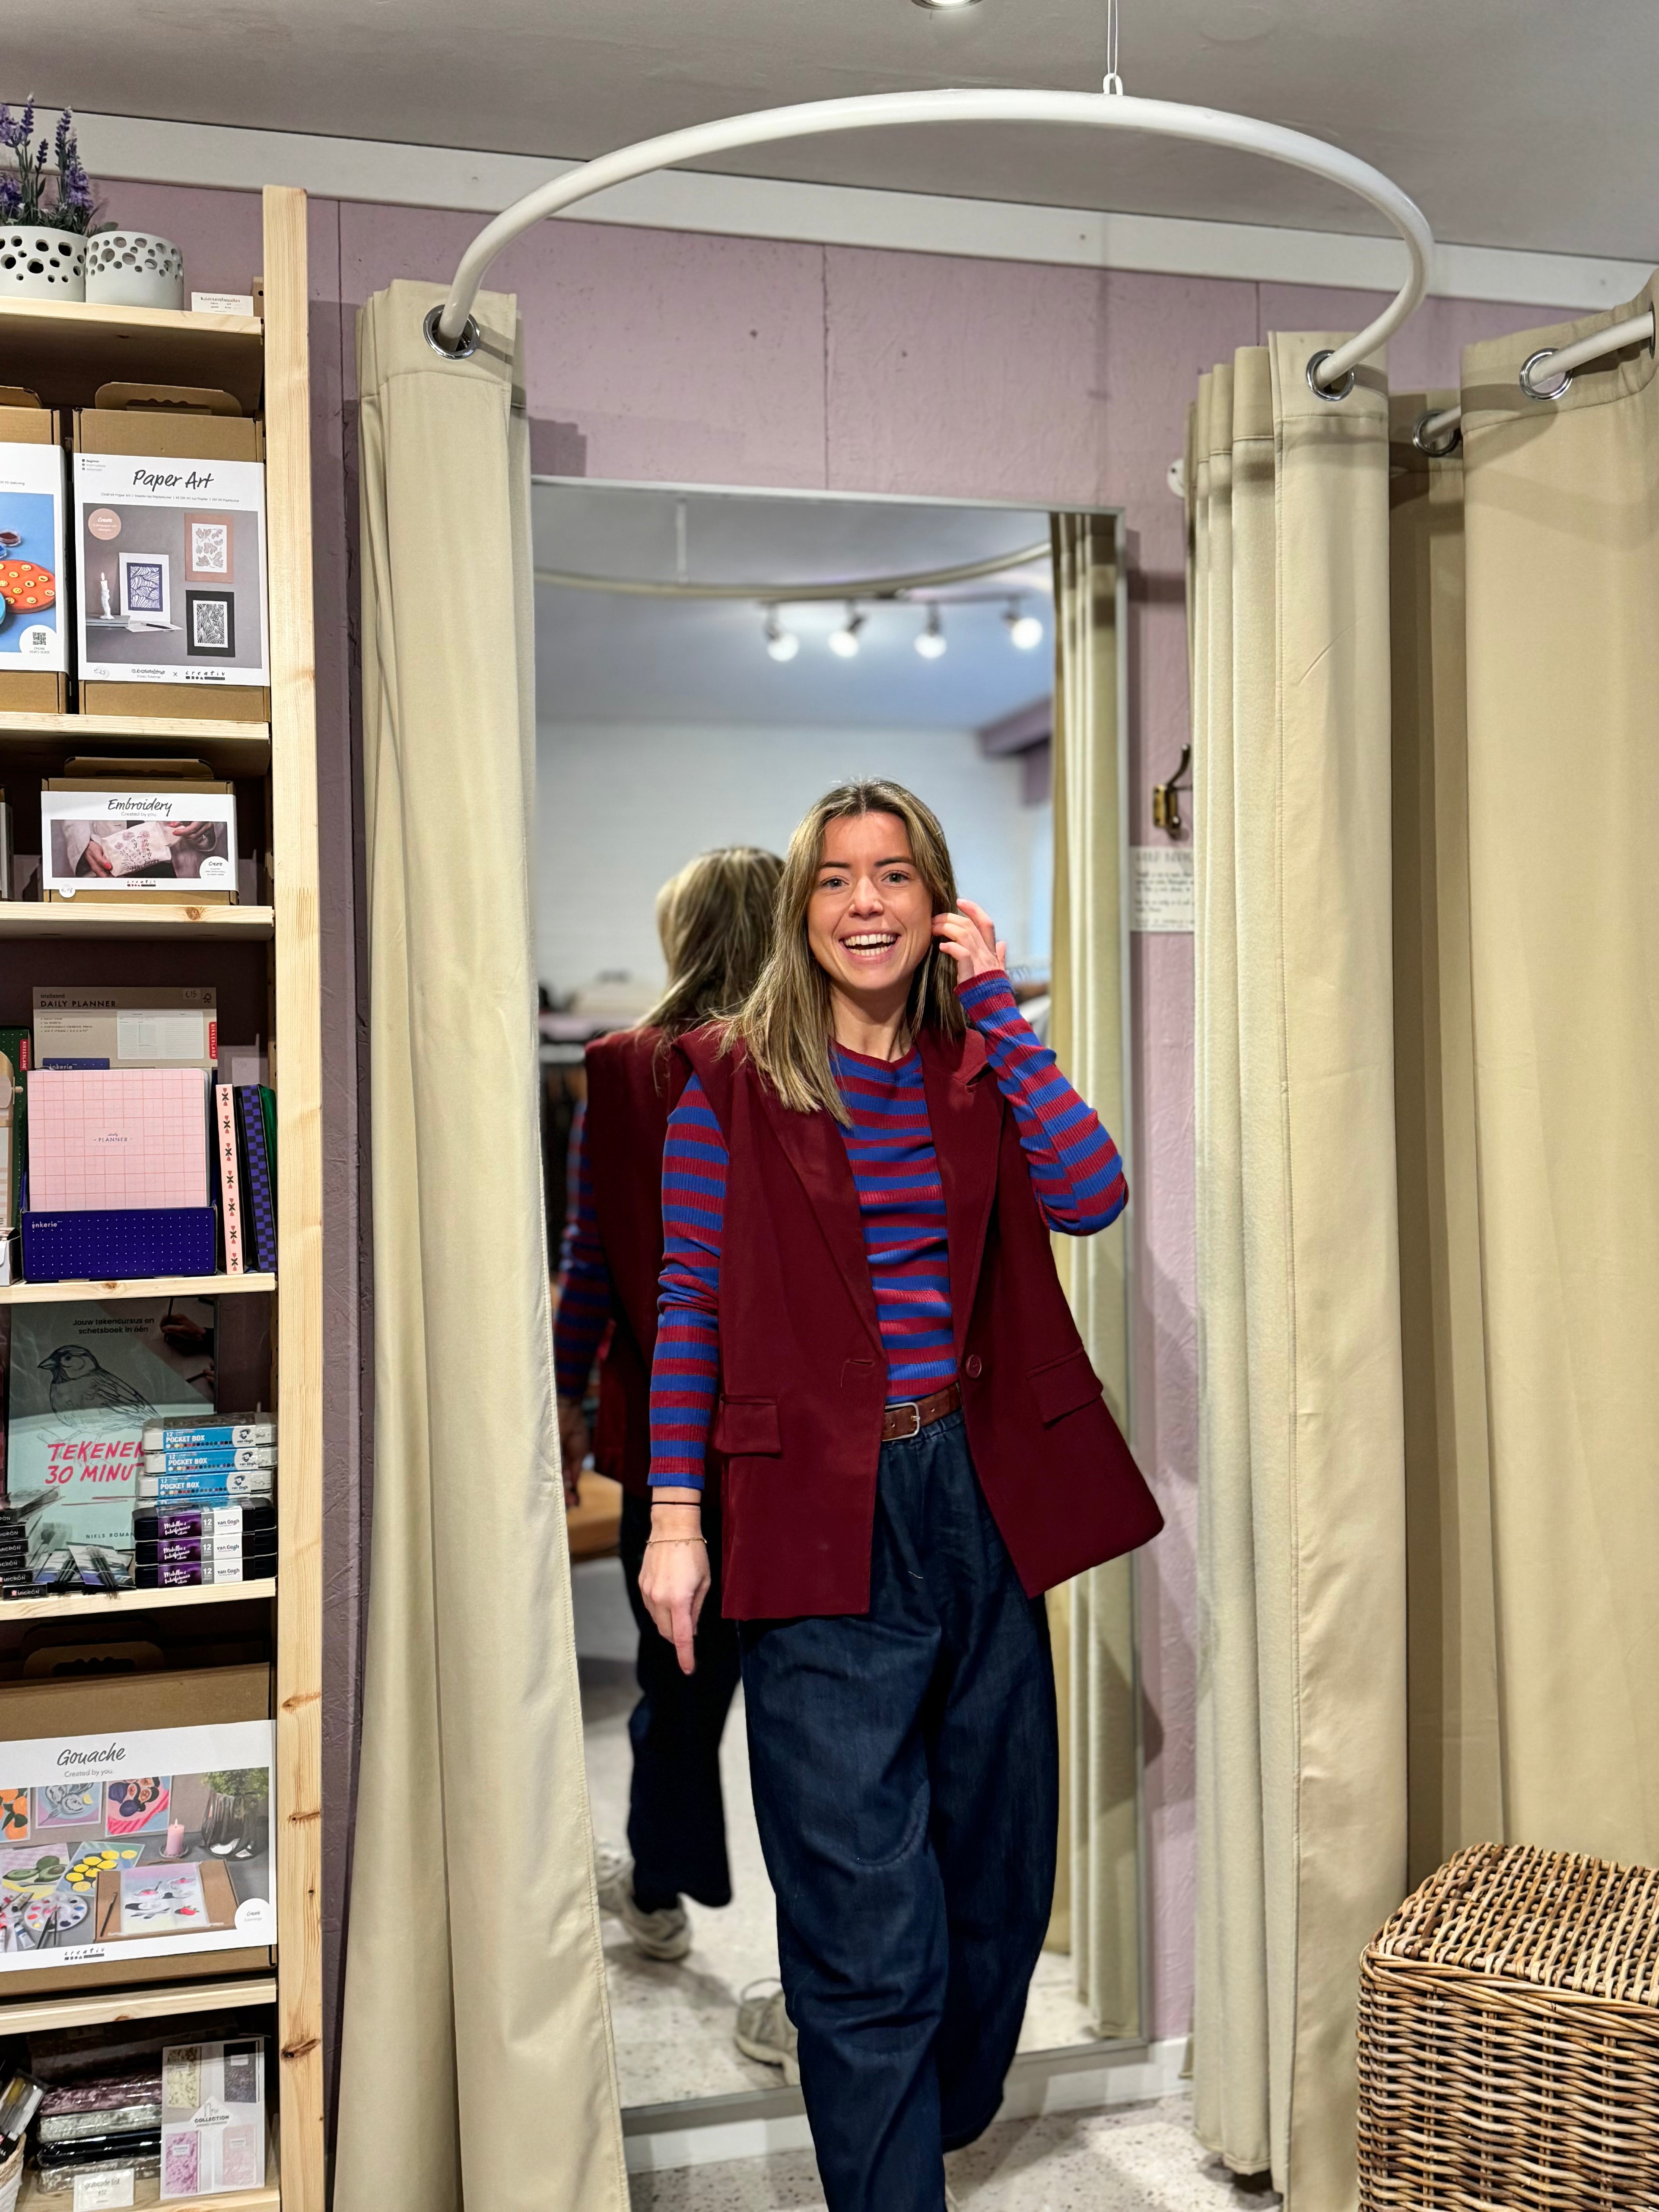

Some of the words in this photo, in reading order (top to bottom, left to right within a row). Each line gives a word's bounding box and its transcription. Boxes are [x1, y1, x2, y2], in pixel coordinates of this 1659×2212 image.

[133, 470, 183, 492] Paper
[185, 471, 214, 490] Art
[108, 798, 172, 817] Embroidery
[45, 1465, 73, 1484] 30
[57, 1742, 126, 1766] Gouache
[194, 2115, 229, 2123] COLLECTION
